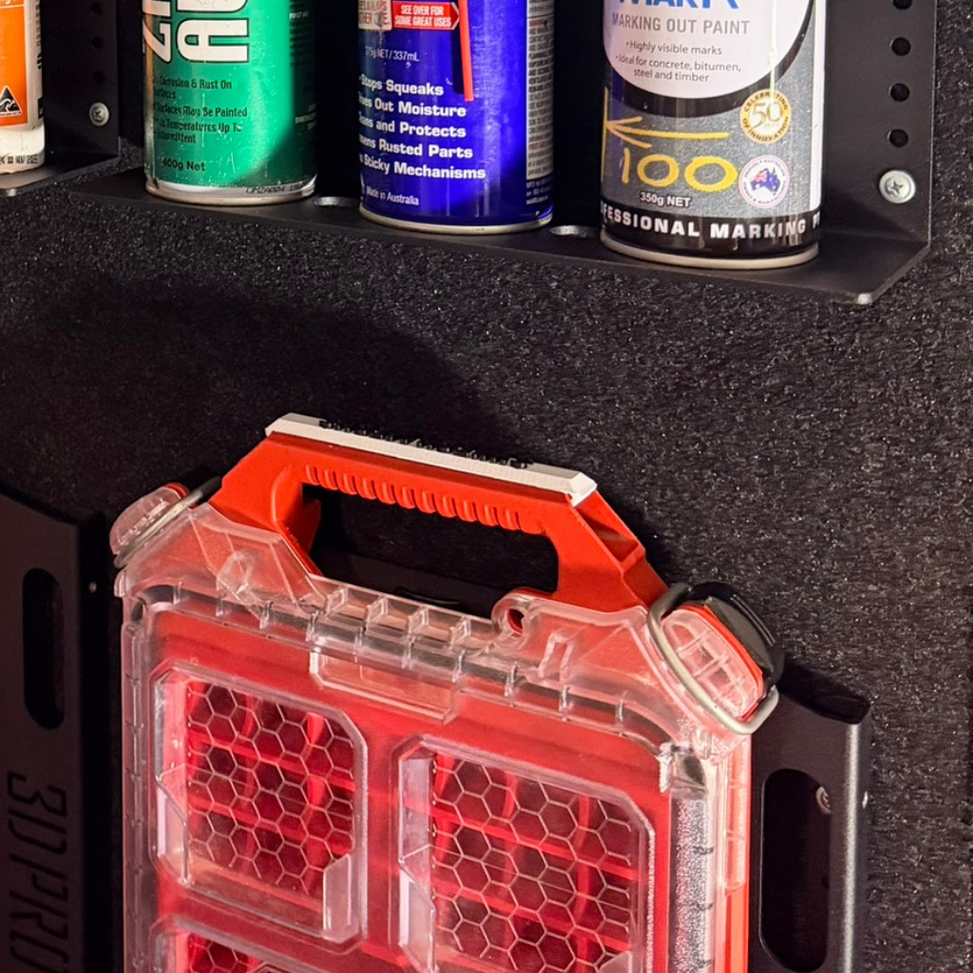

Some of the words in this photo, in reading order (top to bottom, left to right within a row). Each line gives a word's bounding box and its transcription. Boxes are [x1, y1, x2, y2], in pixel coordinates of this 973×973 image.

[430, 6, 444, 16] FOR
[412, 16, 433, 26] GREAT
[434, 16, 452, 27] USES
[612, 13, 661, 31] MARKING
[666, 18, 697, 33] OUT
[703, 19, 751, 35] PAINT
[629, 40, 656, 53] Highly
[658, 42, 688, 54] visible
[691, 45, 723, 55] marks
[635, 56, 647, 66] for
[648, 58, 693, 71] concrete,
[694, 60, 742, 72] bitumen,
[633, 69, 653, 78] steel
[654, 70, 672, 80] and
[675, 72, 709, 82] timber
[200, 79, 219, 90] Rust
[220, 79, 232, 89] On
[386, 79, 444, 96] Squeaks
[374, 97, 394, 112] Out
[398, 101, 466, 117] Moisture
[743, 91, 789, 113] CELEBRTING
[182, 106, 201, 118] May
[215, 107, 248, 118] Painted
[752, 100, 784, 129] 50
[218, 123, 231, 134] Up
[376, 120, 395, 134] and
[399, 122, 466, 138] Protects
[378, 138, 423, 156] Rusted
[428, 144, 474, 158] Parts
[162, 158, 184, 171] 400g
[186, 160, 205, 171] Net
[393, 162, 487, 179] Mechanisms
[621, 147, 739, 193] 100
[386, 190, 419, 206] Australia
[639, 191, 665, 207] 350g
[667, 194, 692, 208] NET
[601, 203, 701, 238] FESSIONAL
[709, 218, 806, 239] MARKING
